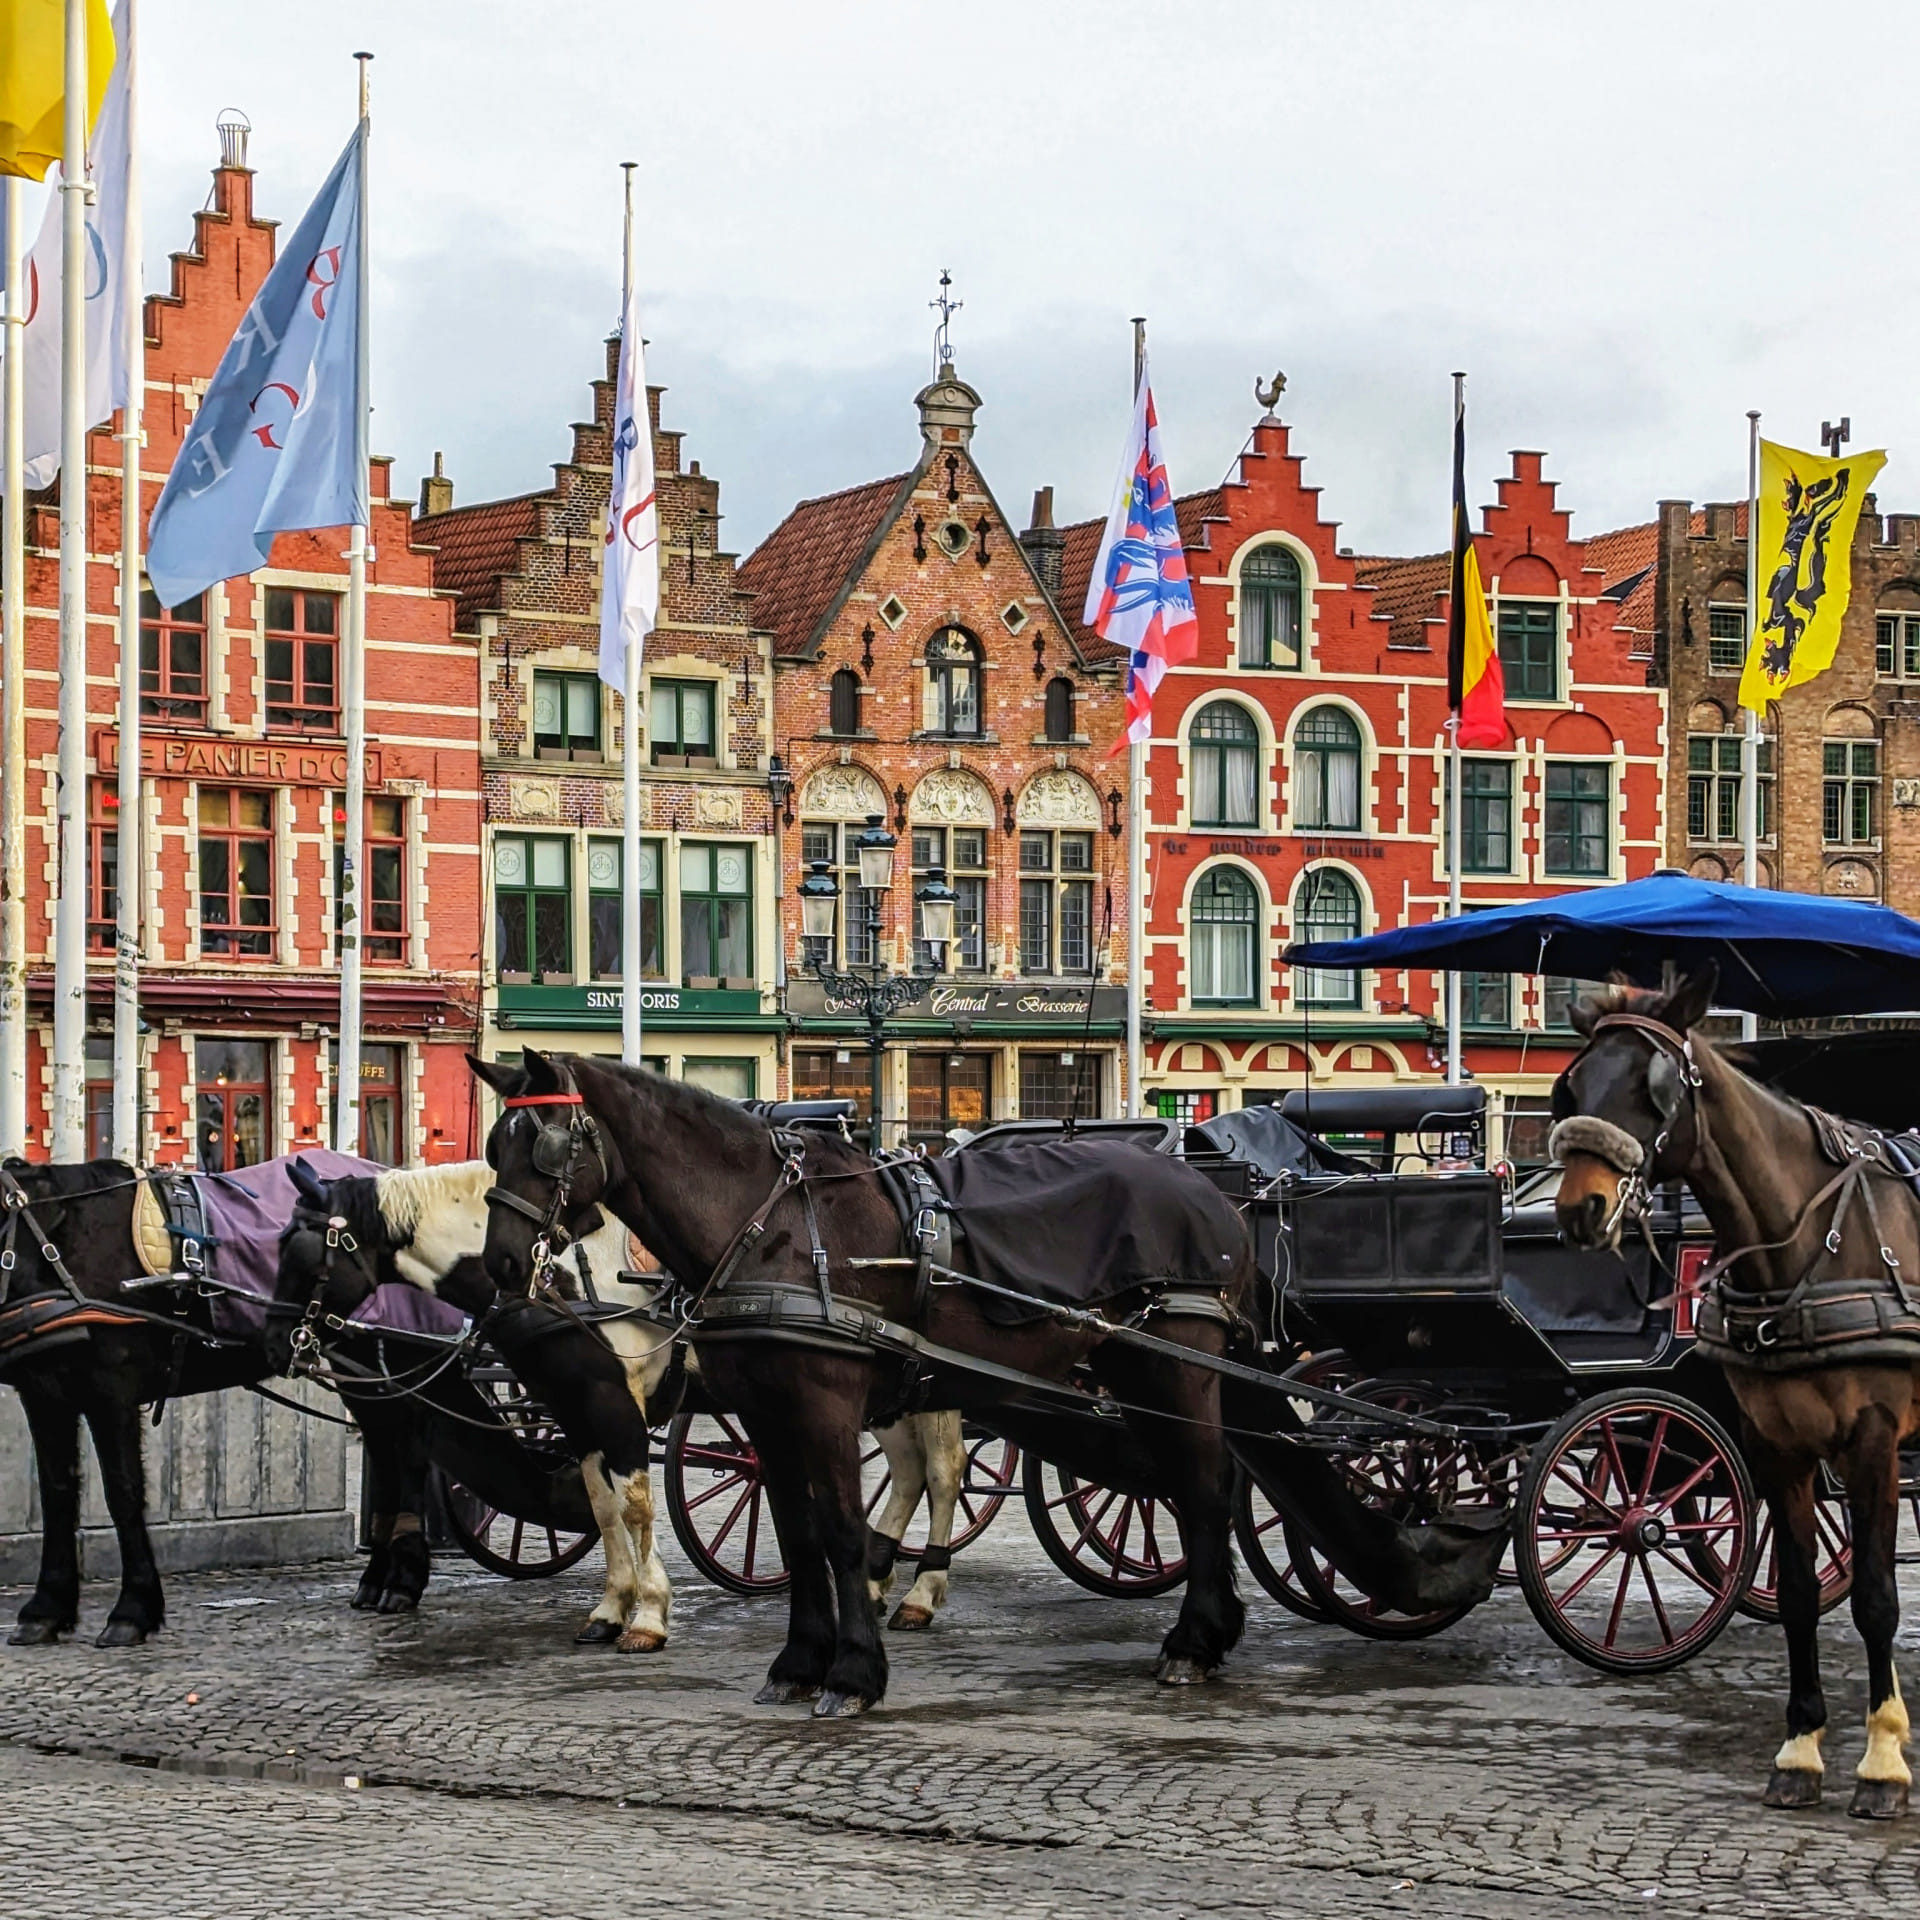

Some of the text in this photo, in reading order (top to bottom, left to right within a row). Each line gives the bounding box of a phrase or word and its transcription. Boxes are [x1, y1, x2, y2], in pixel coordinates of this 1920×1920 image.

[165, 742, 289, 778] PANIER
[587, 992, 680, 1010] SINT ORIS
[930, 988, 988, 1016] Central
[1017, 995, 1089, 1014] Brasserie
